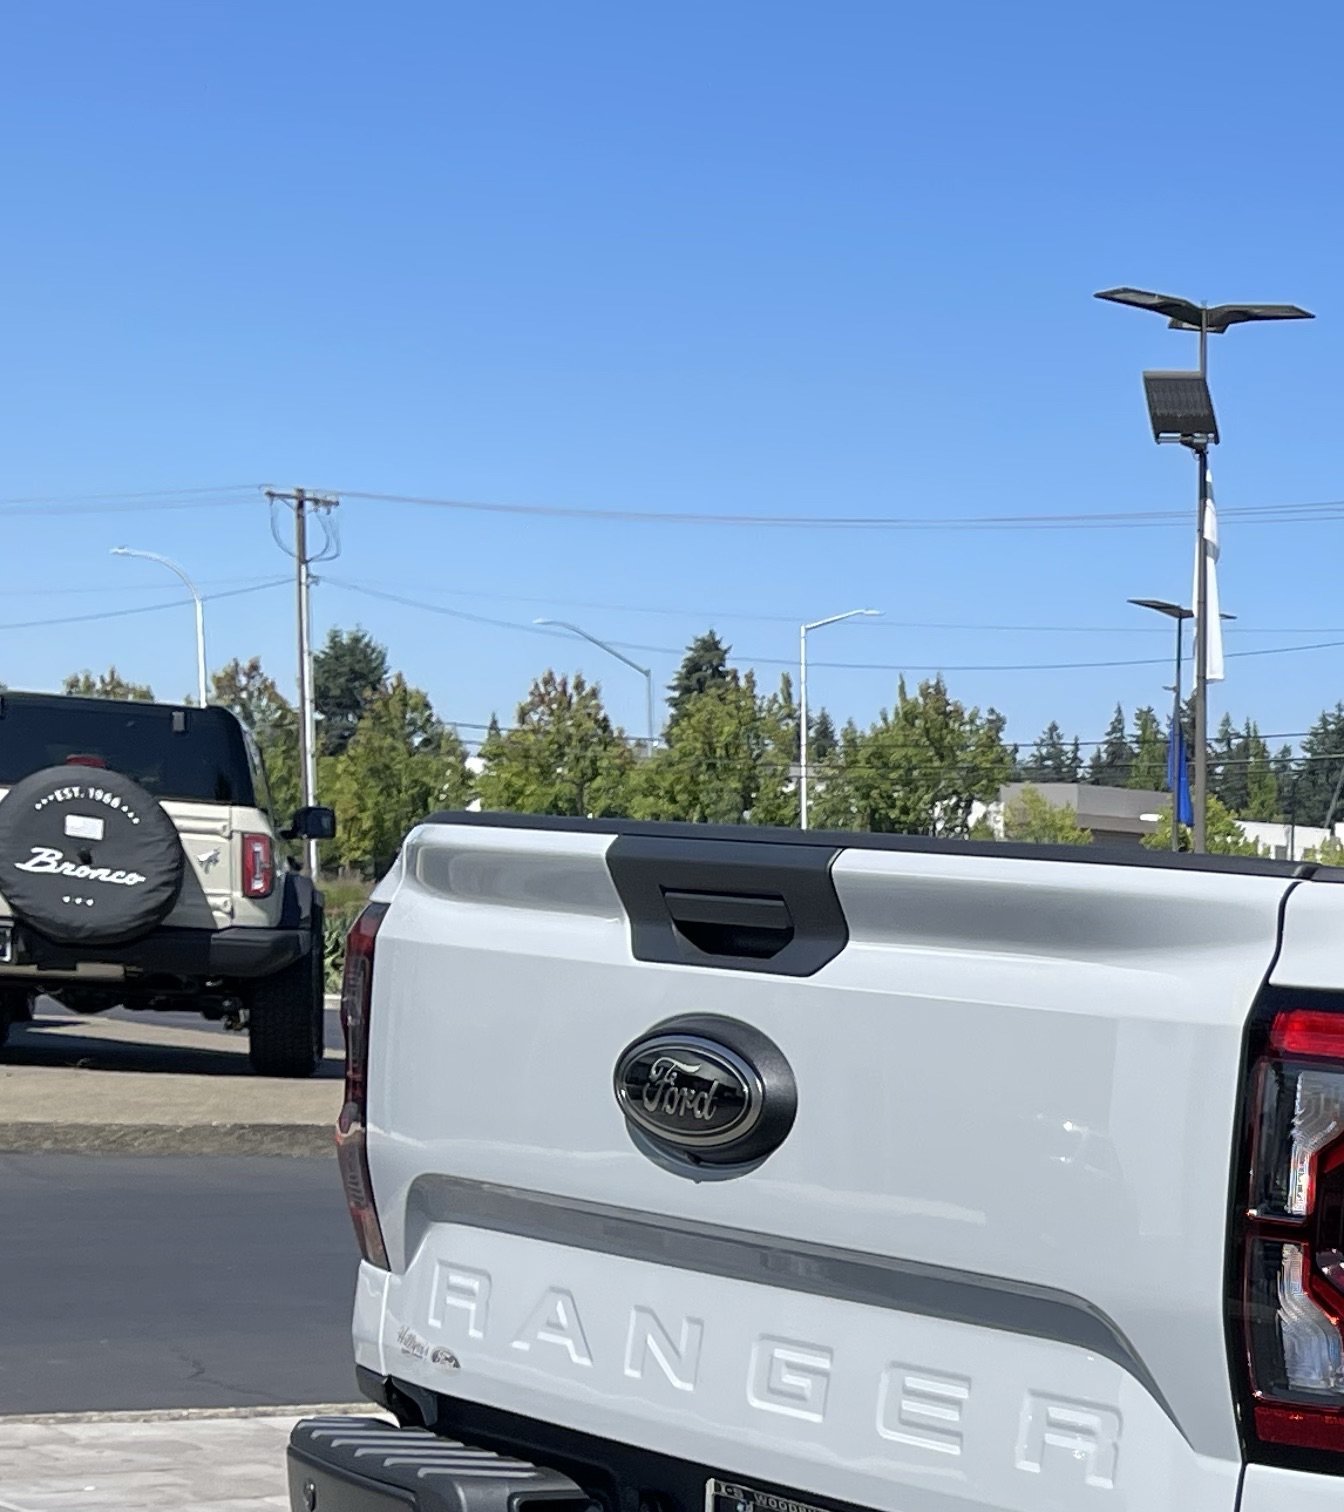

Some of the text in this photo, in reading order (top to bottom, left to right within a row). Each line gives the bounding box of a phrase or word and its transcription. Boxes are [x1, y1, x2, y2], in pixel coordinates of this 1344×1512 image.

[14, 846, 146, 885] Bronco
[642, 1056, 720, 1121] Ford
[428, 1260, 1125, 1491] RANGER
